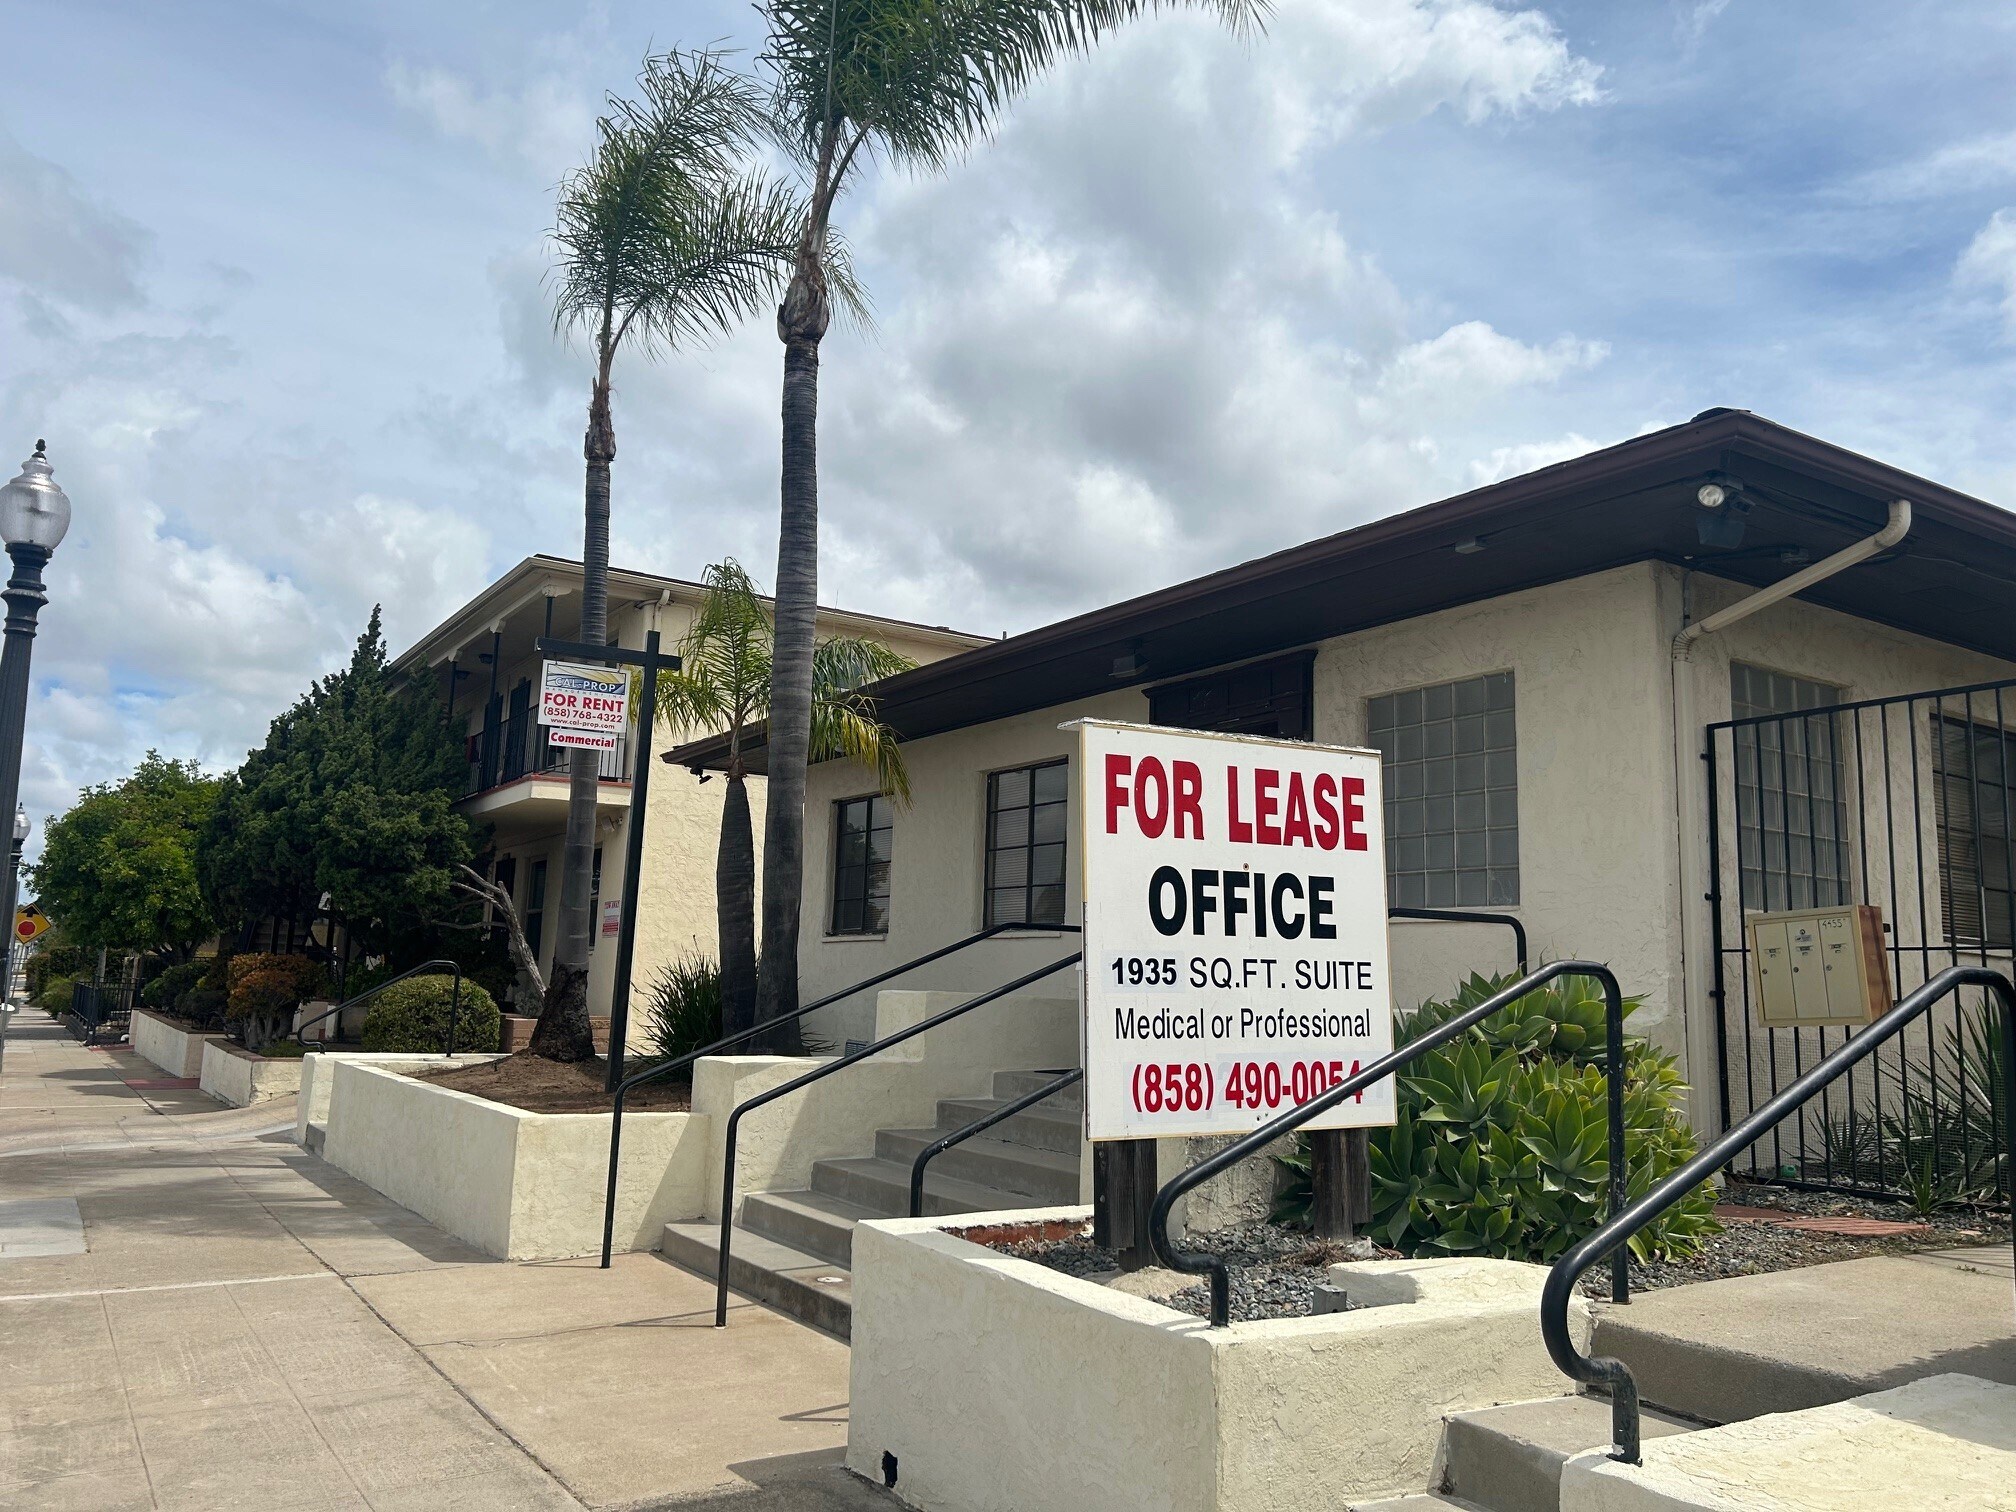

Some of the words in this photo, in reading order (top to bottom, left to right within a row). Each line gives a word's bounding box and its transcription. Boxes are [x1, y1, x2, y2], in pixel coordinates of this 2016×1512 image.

[555, 677, 616, 692] CAL-PROP
[543, 706, 571, 718] (858)
[572, 709, 623, 723] 768-4322
[544, 692, 577, 707] FOR
[583, 697, 624, 712] RENT
[551, 718, 615, 729] www.cal-prop.com
[551, 732, 615, 747] Commercial
[1105, 753, 1204, 840] FOR
[1227, 765, 1368, 851] LEASE
[1148, 865, 1337, 940] OFFICE
[1111, 957, 1177, 986] 1935
[1189, 957, 1286, 989] SQ.FT.
[1295, 959, 1373, 990] SUITE
[1115, 1007, 1204, 1040] Medical
[1211, 1016, 1233, 1038] or
[1240, 1008, 1371, 1038] Professional
[1132, 1063, 1214, 1113] (858)
